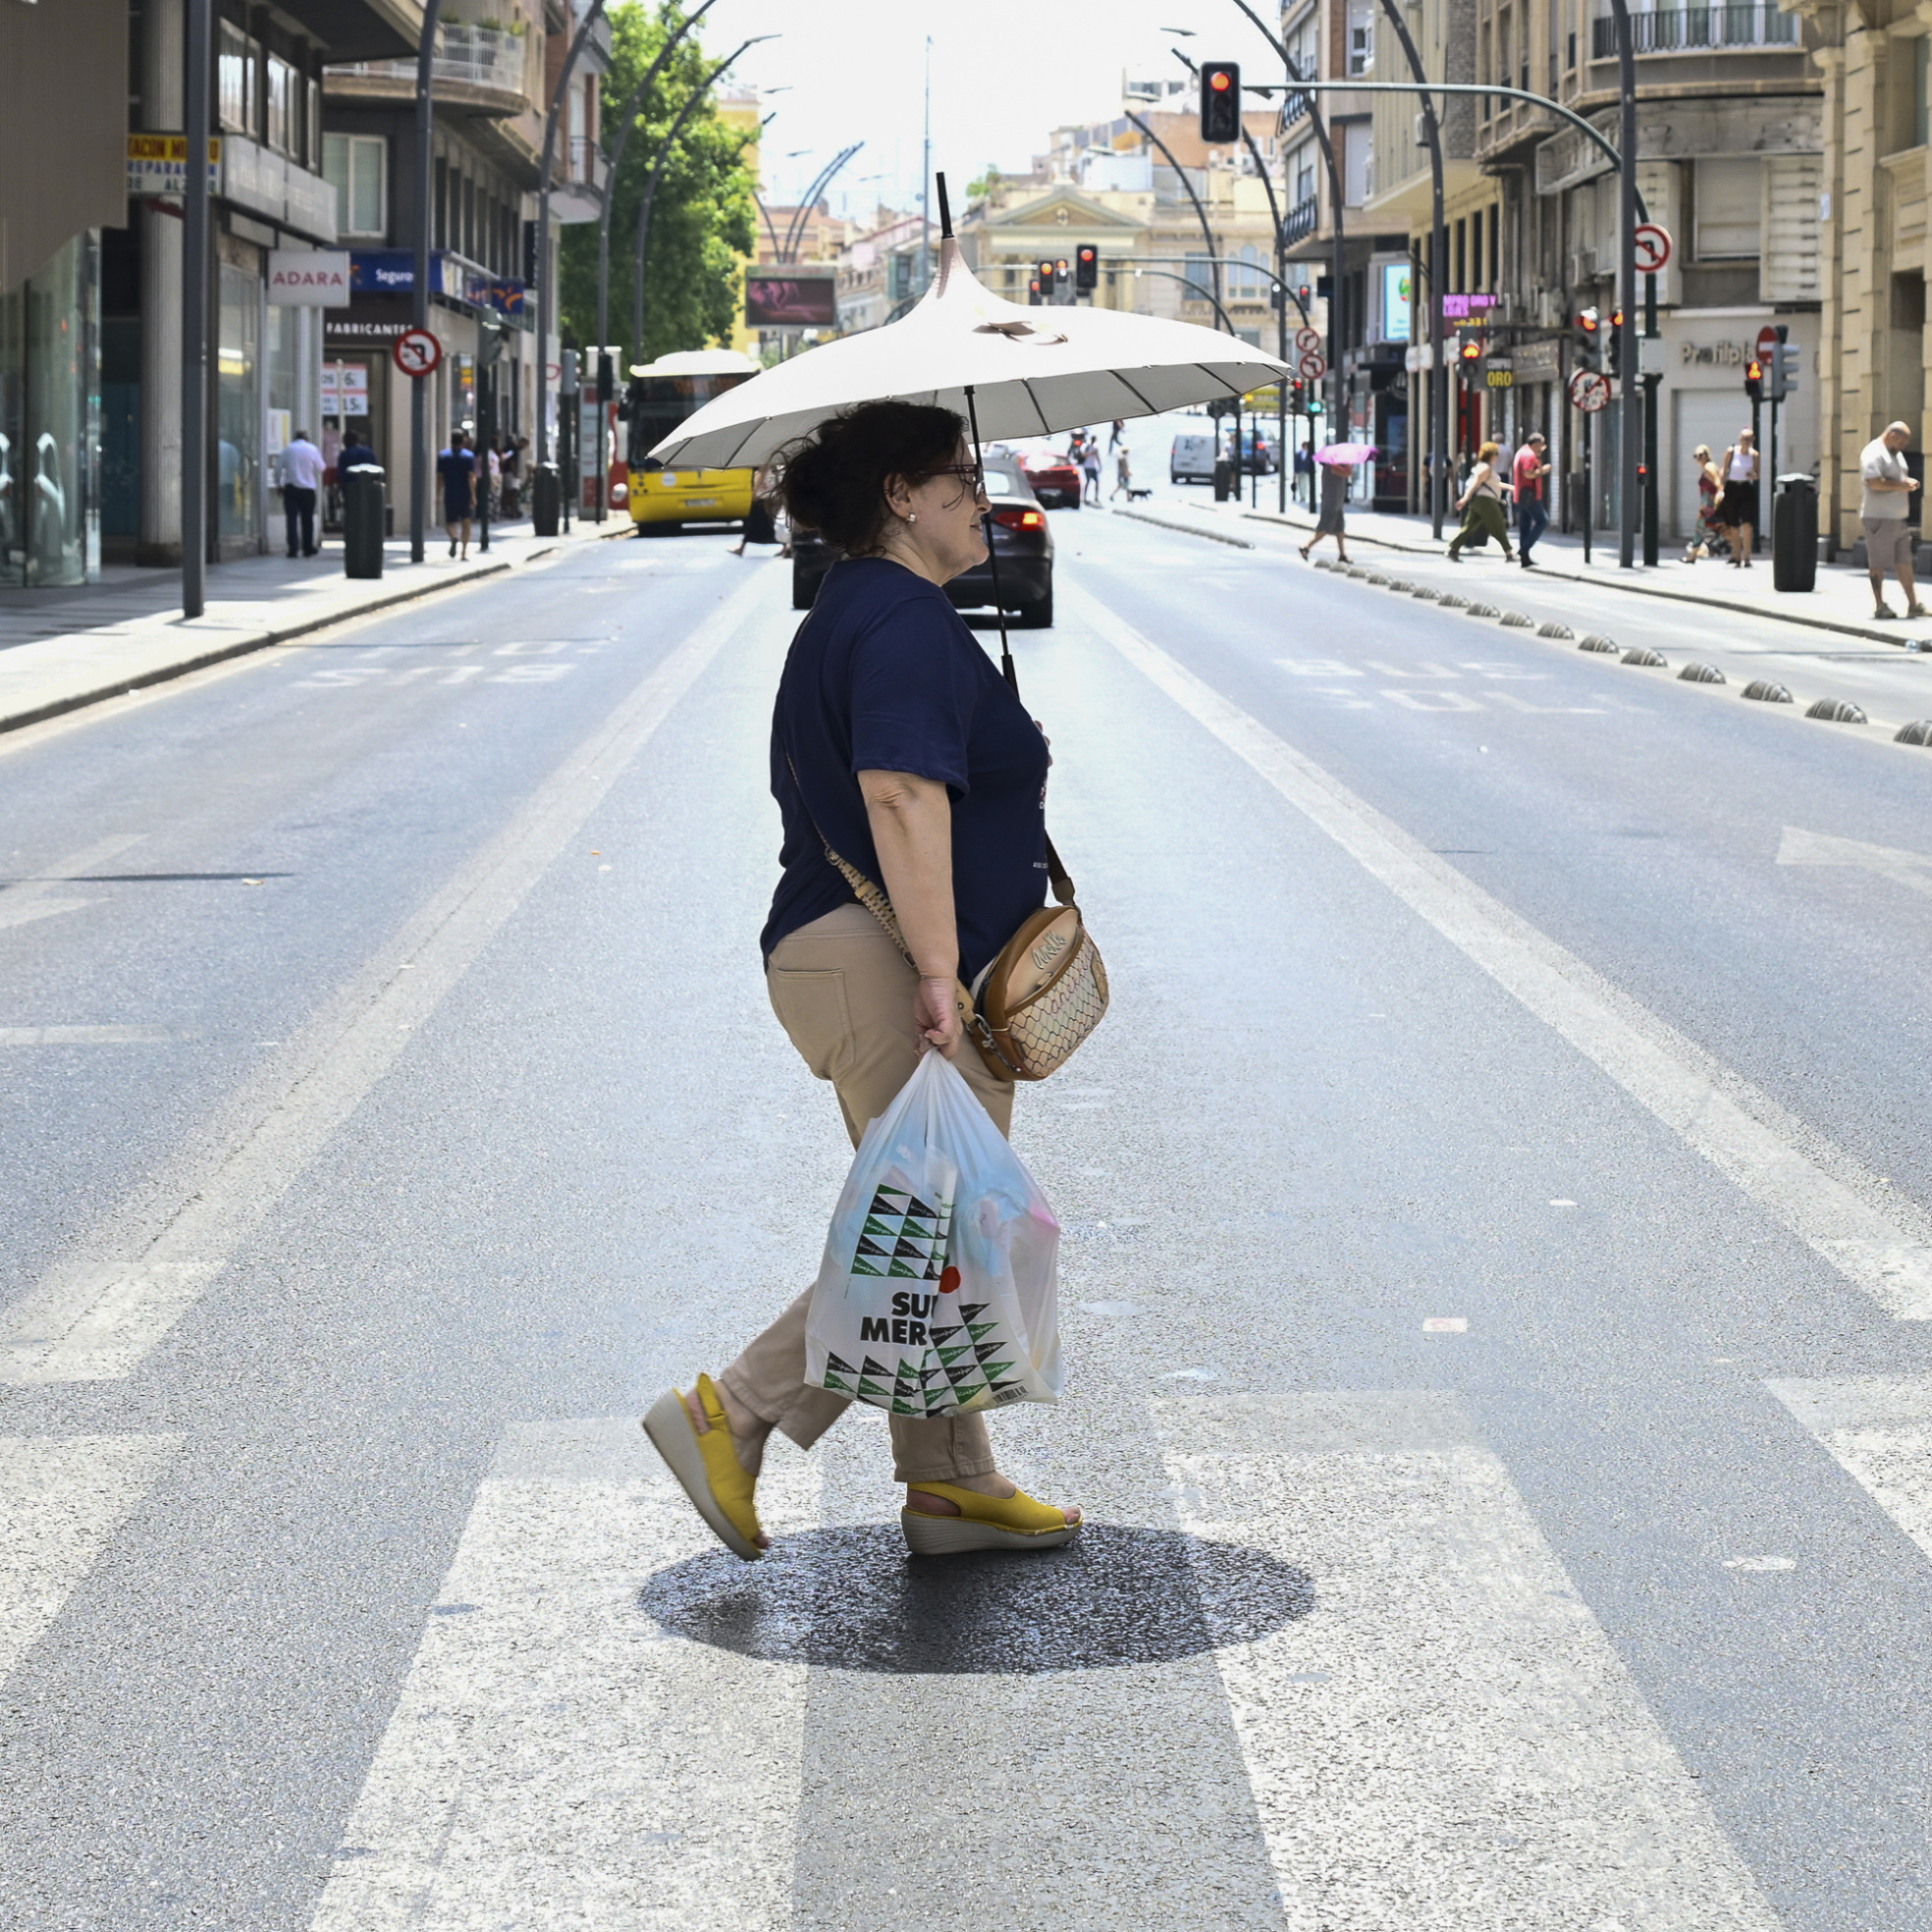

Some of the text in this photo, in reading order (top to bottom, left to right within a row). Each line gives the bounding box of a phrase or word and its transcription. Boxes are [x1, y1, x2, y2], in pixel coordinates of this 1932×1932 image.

[272, 271, 343, 286] ADARA
[375, 268, 414, 286] Seguro
[1681, 342, 1756, 364] Profilpla
[1487, 371, 1512, 387] ORO
[860, 1316, 928, 1346] MER
